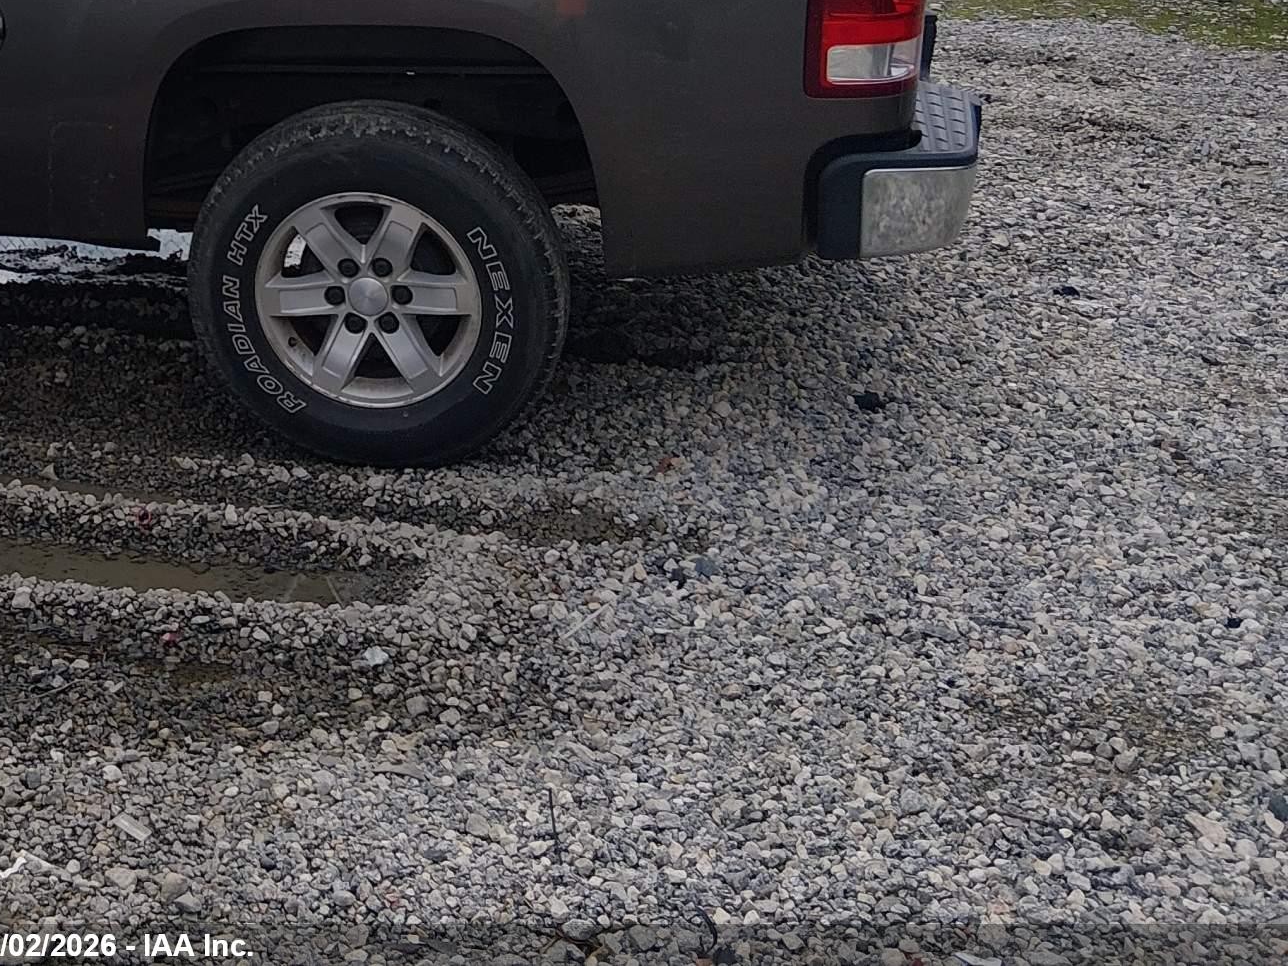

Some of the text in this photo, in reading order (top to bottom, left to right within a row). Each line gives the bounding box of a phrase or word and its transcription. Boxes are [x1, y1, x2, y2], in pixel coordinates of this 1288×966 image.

[221, 204, 308, 414] ROADIAN HTX
[467, 226, 515, 395] NEXEN
